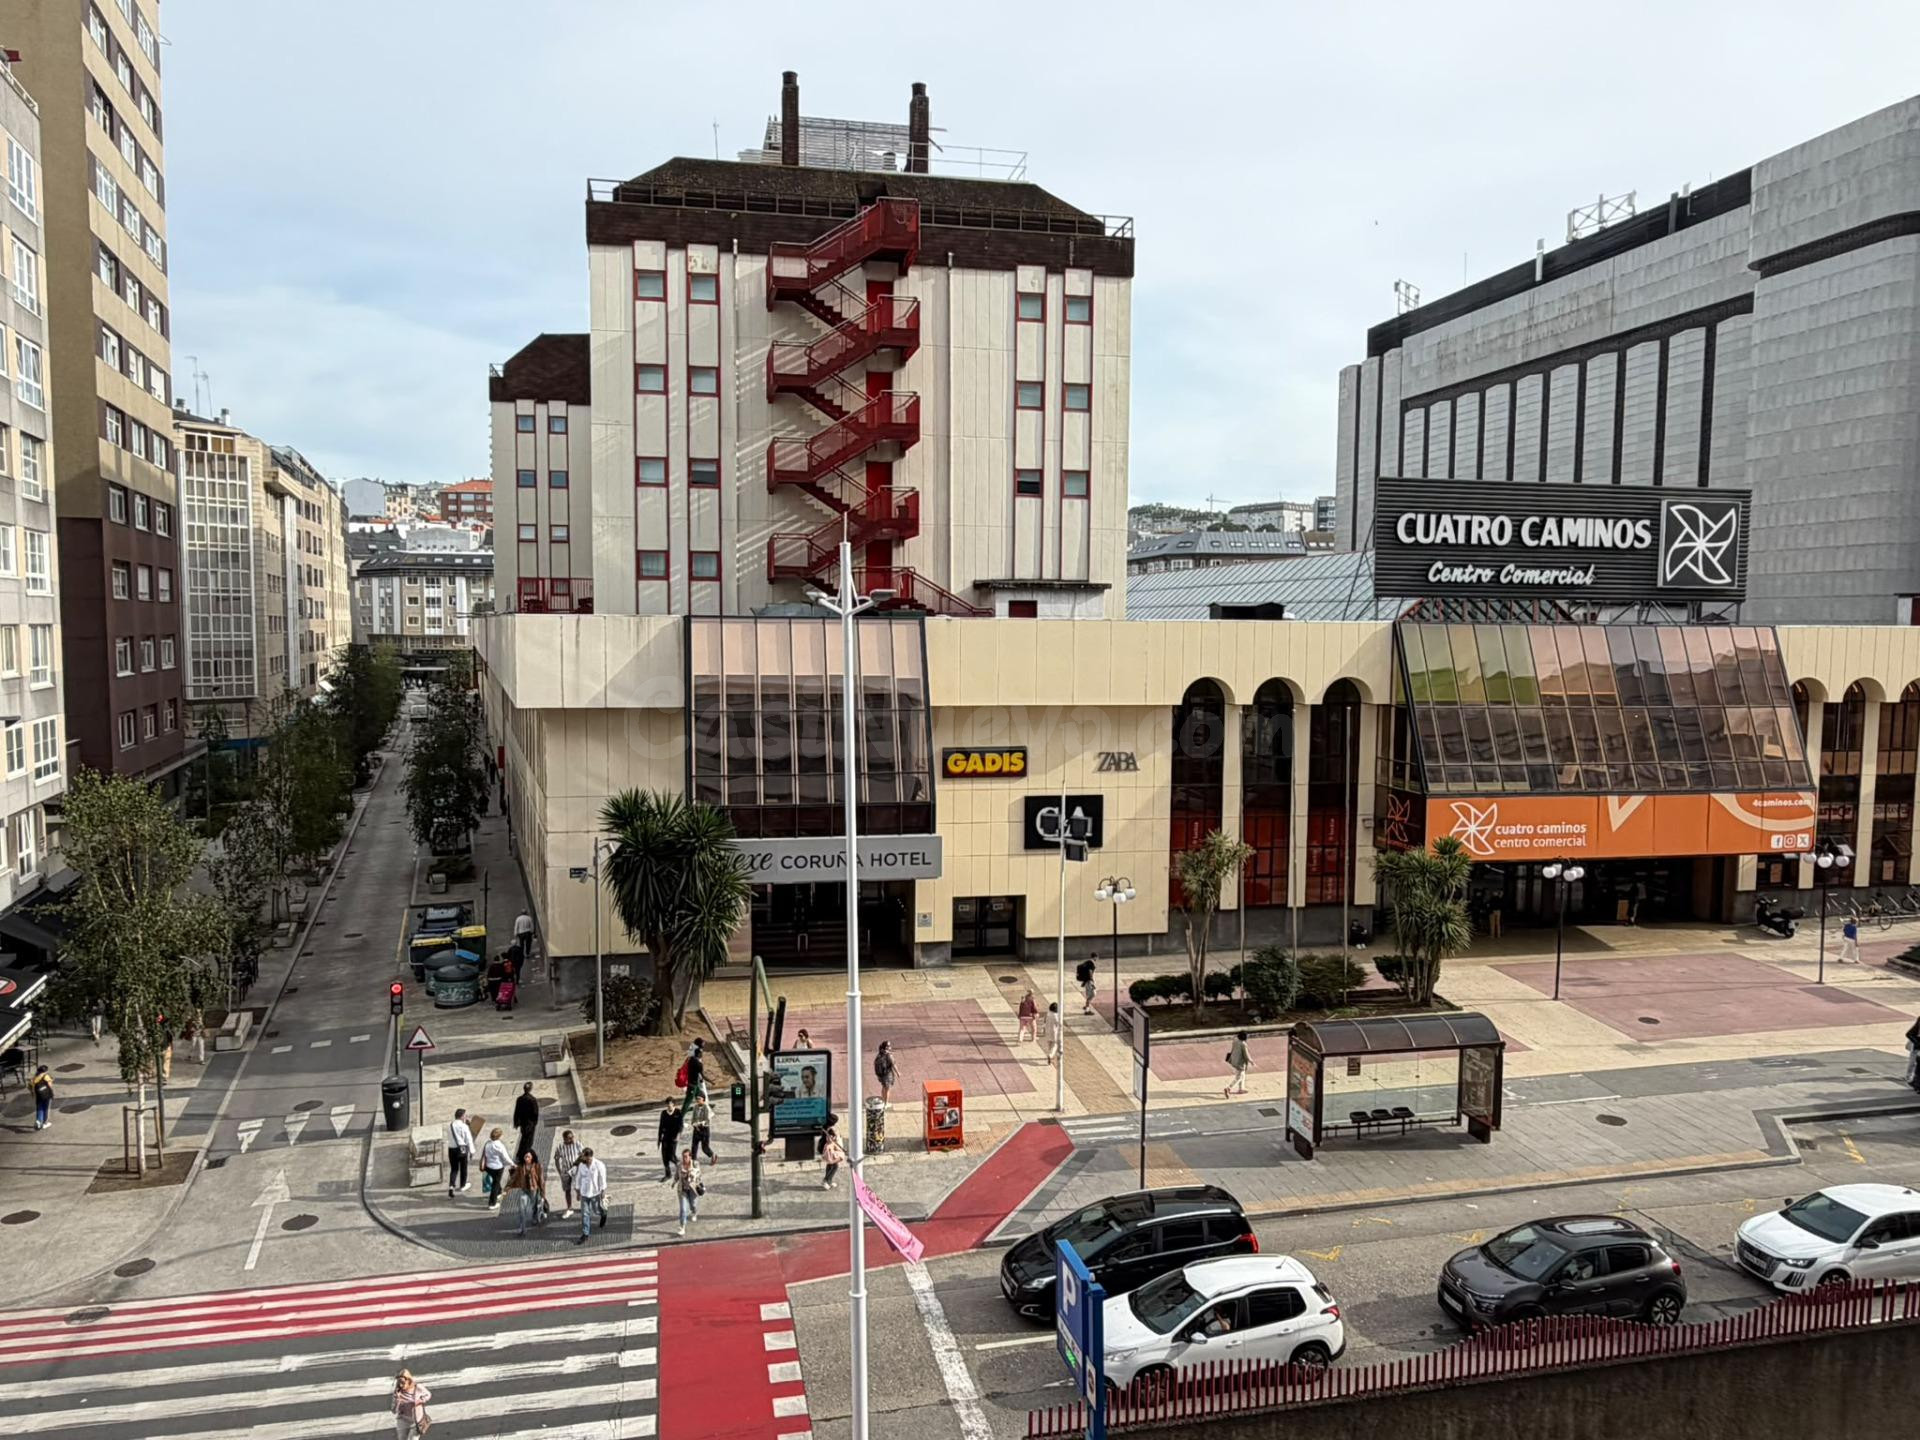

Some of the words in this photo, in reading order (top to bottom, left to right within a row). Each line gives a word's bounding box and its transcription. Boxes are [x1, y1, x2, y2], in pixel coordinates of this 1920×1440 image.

[1396, 512, 1512, 547] CUATRO
[1520, 516, 1653, 550] CAMINOS
[1427, 560, 1495, 584] Centro
[1499, 562, 1596, 586] Comercial
[946, 752, 1025, 774] GADIS
[1495, 823, 1534, 835] cuatro
[1537, 821, 1587, 834] caminos
[1494, 838, 1530, 848] centro
[1533, 835, 1586, 847] comercial
[732, 852, 773, 871] exe
[870, 852, 932, 867] HOTEL
[1062, 1260, 1077, 1316] P
